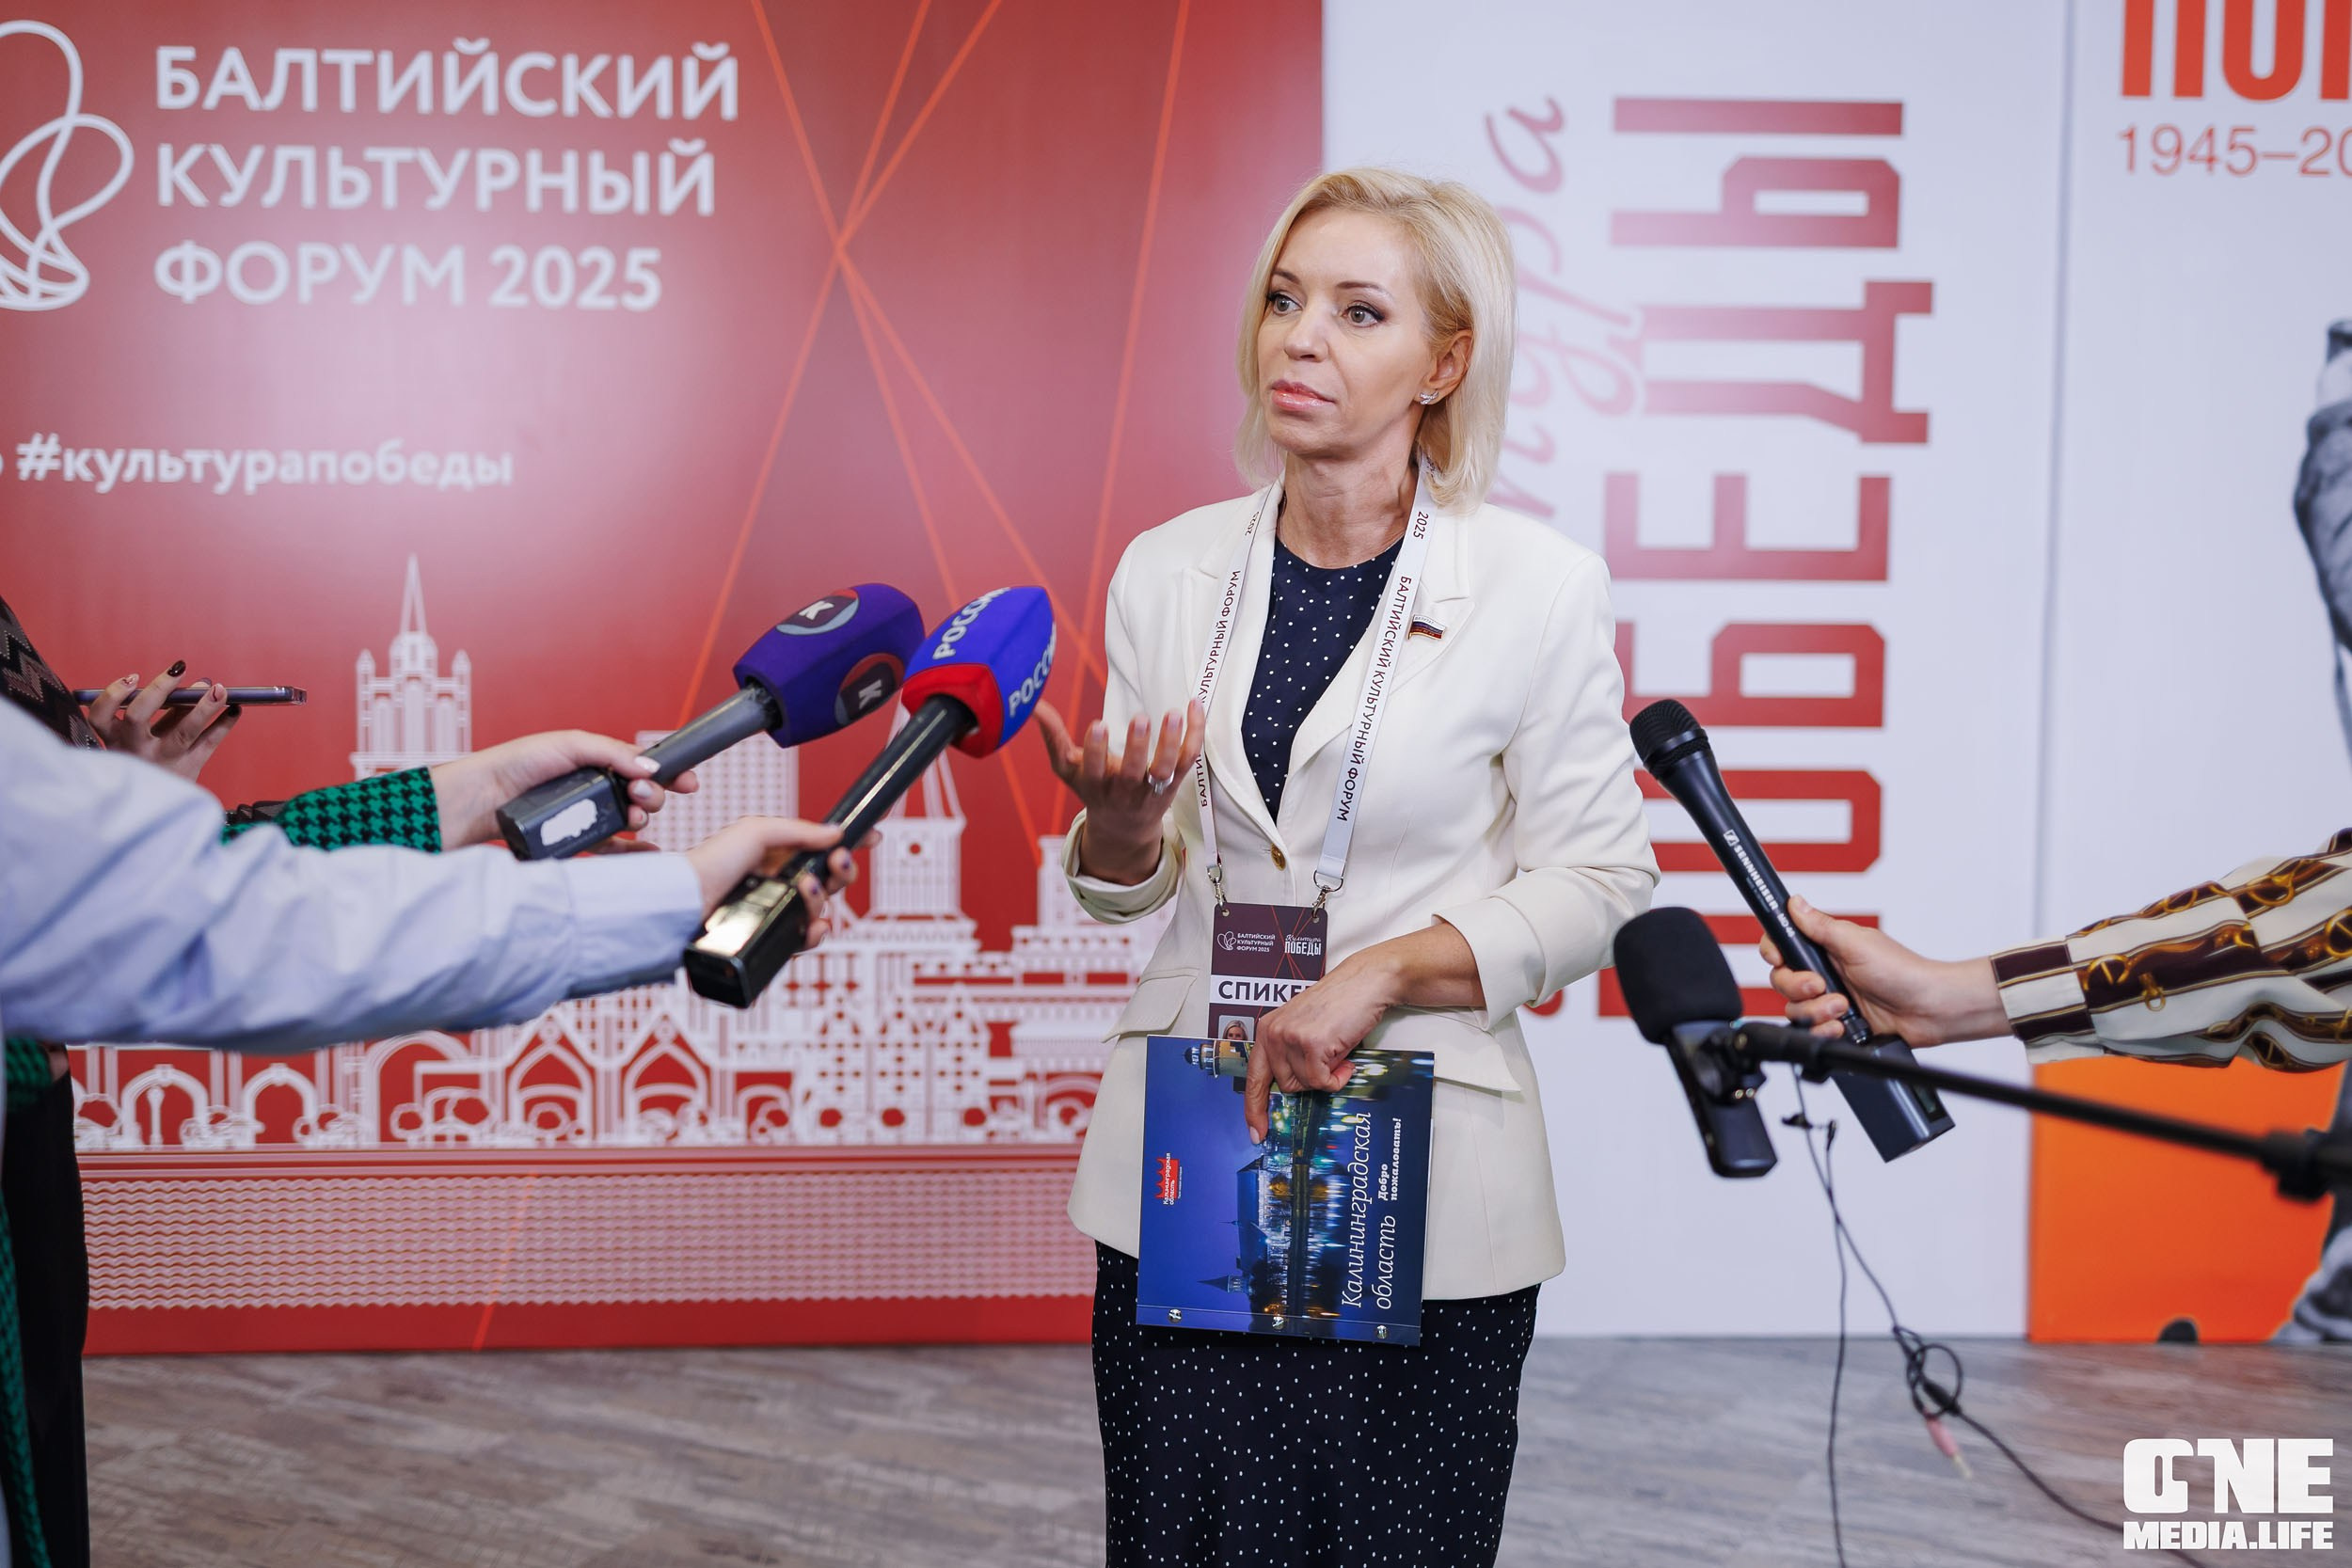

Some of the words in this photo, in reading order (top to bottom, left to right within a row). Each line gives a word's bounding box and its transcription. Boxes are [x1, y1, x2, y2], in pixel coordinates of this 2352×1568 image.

[155, 37, 739, 120] БАЛТИЙСКИЙ
[155, 138, 716, 217] КУЛЬТУРНЫЙ
[153, 239, 468, 307] ФОРУМ
[487, 245, 663, 311] 2025
[16, 432, 515, 495] #культурапобеды
[1413, 511, 1429, 540] 2025
[1222, 570, 1241, 618] ФОРУМ
[1375, 576, 1411, 668] БАЛТИЙСКИЙ
[1350, 670, 1384, 767] КУЛЬТУРНЫЙ
[1336, 767, 1359, 822] ФОРУМ
[1733, 844, 1779, 911] SENNHEISER
[1237, 932, 1276, 941] БАЛТИЙСКИЙ
[1284, 941, 1322, 957] ПОБЕДЫ
[1218, 980, 1311, 1003] СПИКЕ
[1378, 1163, 1389, 1201] Добро
[1391, 1117, 1402, 1201] пожаловать!
[1342, 1112, 1373, 1307] Калининградская
[1372, 1214, 1396, 1310] область
